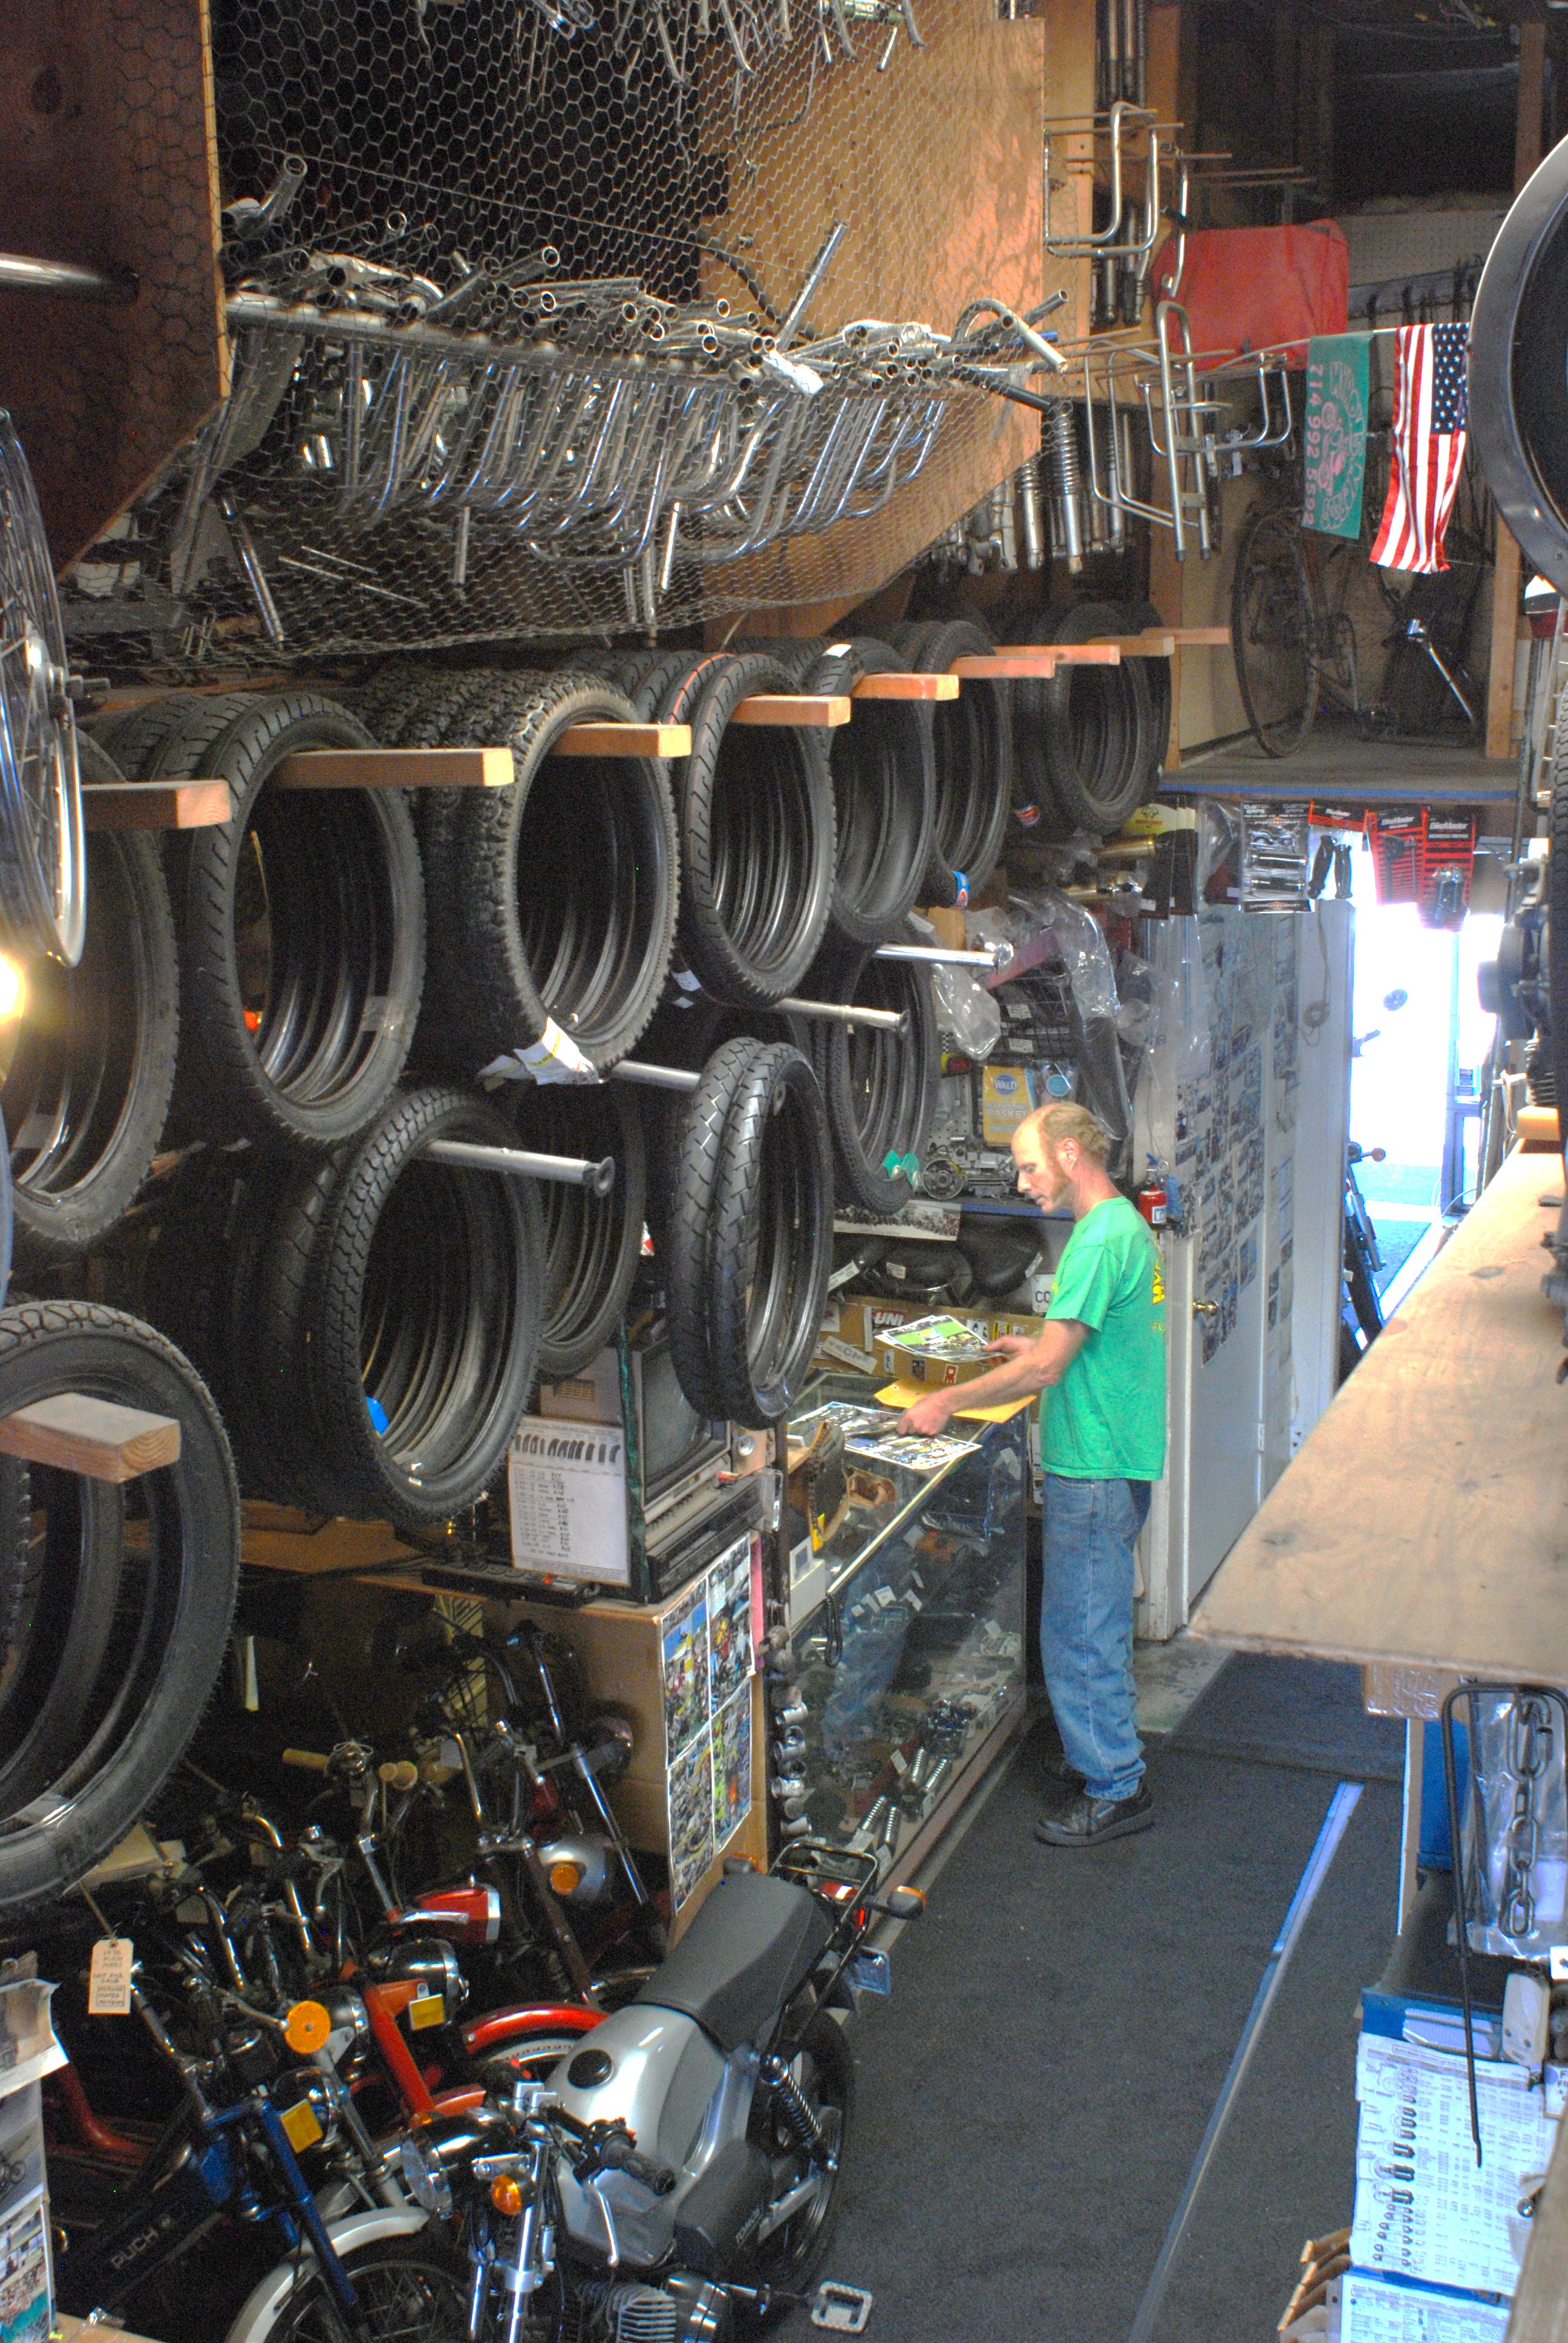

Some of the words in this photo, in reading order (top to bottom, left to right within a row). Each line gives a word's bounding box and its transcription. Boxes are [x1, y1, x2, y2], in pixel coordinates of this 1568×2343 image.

[1309, 364, 1324, 406] 714
[1307, 415, 1322, 458] 992
[1304, 467, 1319, 525] 5592
[994, 1080, 1018, 1090] WALD
[987, 1109, 1027, 1118] BASKET
[874, 1311, 904, 1326] UNI
[111, 2227, 158, 2270] PUCH
